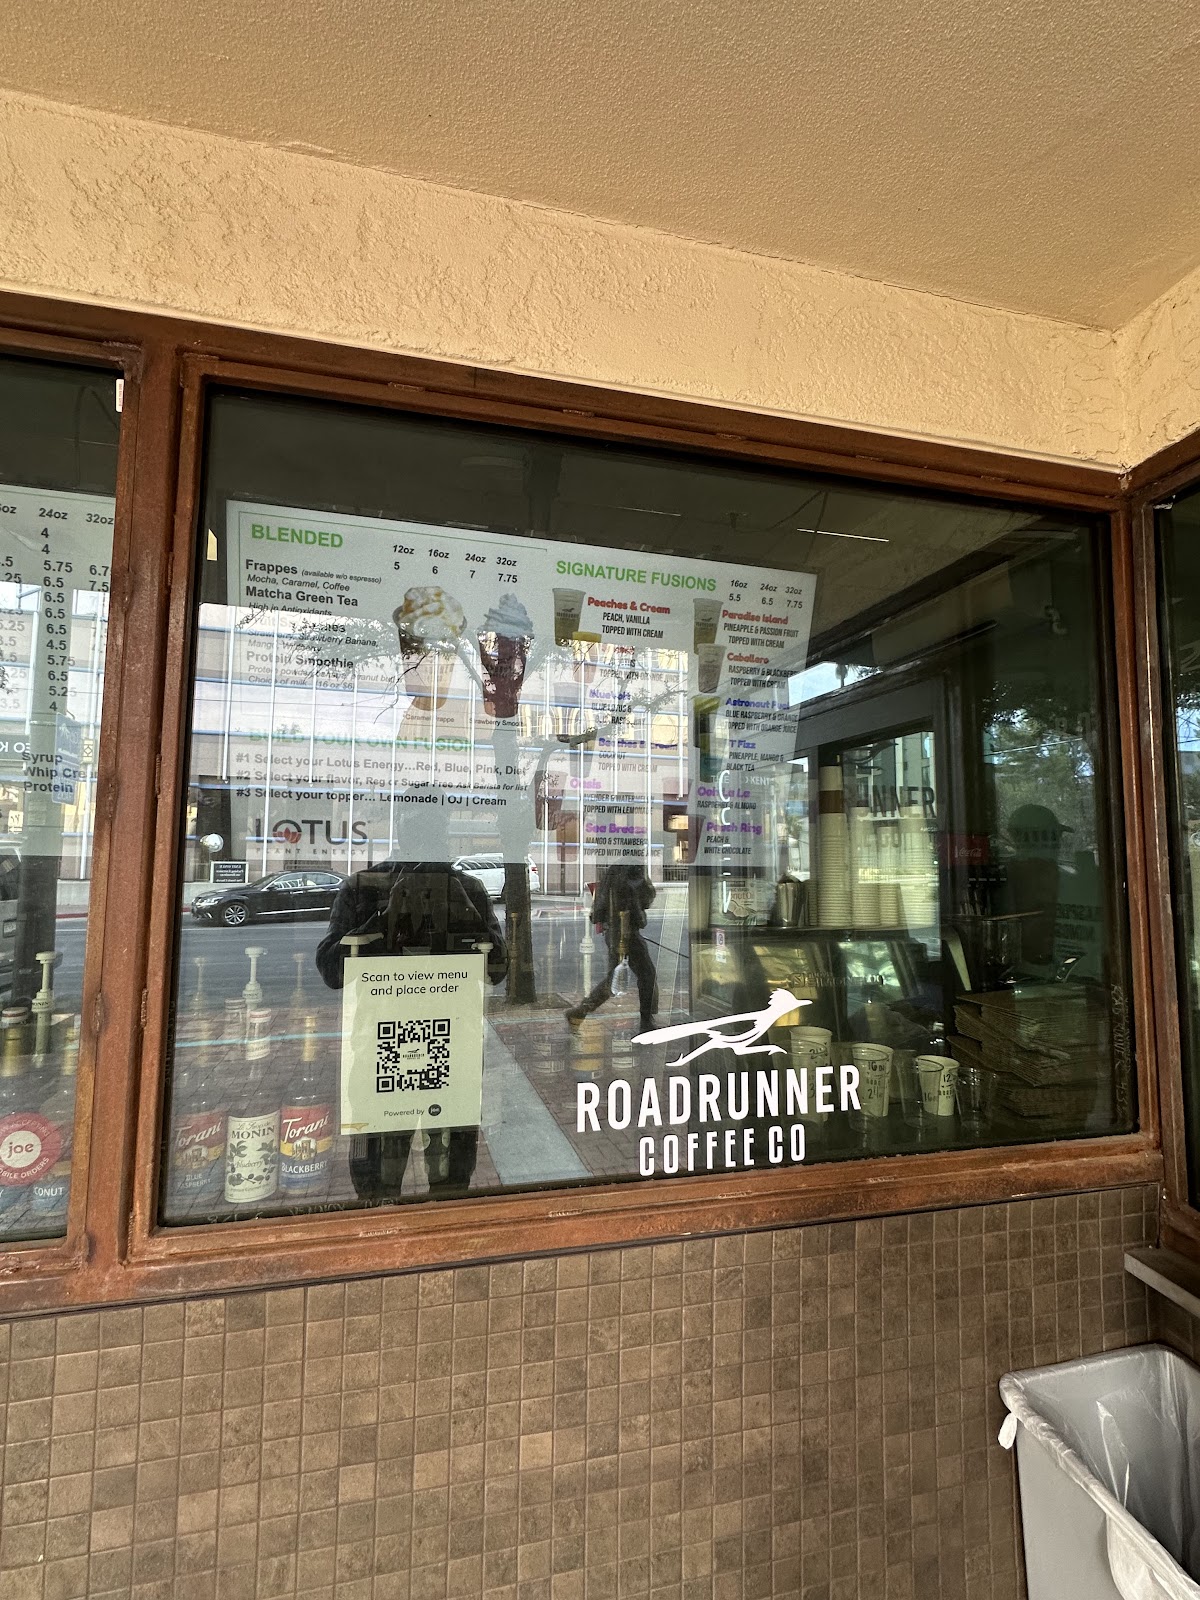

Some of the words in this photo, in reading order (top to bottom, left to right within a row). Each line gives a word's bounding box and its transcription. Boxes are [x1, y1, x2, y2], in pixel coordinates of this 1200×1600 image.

[39, 507, 68, 520] 24oz
[86, 513, 114, 525] 32oz
[41, 527, 50, 539] 4
[252, 524, 343, 549] BLENDED
[42, 544, 50, 555] 4
[392, 544, 415, 555] 12oz
[428, 548, 450, 559] 16oz
[465, 553, 487, 563] 24oz
[496, 557, 517, 567] 32oz
[44, 560, 73, 573] 5.75
[89, 565, 110, 576] 6.7
[245, 559, 298, 575] Frappes
[302, 568, 335, 579] (available
[349, 574, 382, 584] espresso)
[394, 561, 400, 570] 5
[432, 565, 438, 574] 6
[469, 570, 476, 578] 7
[498, 573, 518, 583] 7.75
[43, 576, 64, 588] 6.5
[247, 574, 279, 586] Mocha,
[281, 577, 320, 590] Caramel,
[323, 581, 350, 592] Coffee
[556, 560, 647, 584] SIGNATURE
[651, 571, 717, 592] FUSIONS
[730, 580, 748, 588] 16oz
[760, 583, 778, 592] 24oz
[785, 586, 803, 595] 32oz
[44, 592, 65, 603] 6.5
[245, 585, 292, 601] Matcha
[296, 590, 334, 605] Green
[337, 594, 358, 607] Tea
[728, 593, 741, 602] 5.5
[761, 597, 774, 605] 6.5
[786, 600, 803, 609] 7.75
[587, 597, 628, 610] Peaches
[629, 601, 638, 611] &
[639, 602, 671, 615] Cream
[45, 608, 66, 620] 6.5
[602, 612, 624, 624] PEACH,
[625, 614, 650, 625] VANILLA
[722, 609, 761, 622] Paradise
[762, 613, 789, 625] Island
[46, 624, 67, 635] 6.5
[602, 625, 626, 635] TOPPED
[626, 627, 641, 637] WITH
[642, 628, 664, 639] CREAM
[723, 622, 754, 634] PINEAPPLE
[759, 626, 782, 637] PASSION
[783, 628, 800, 638] FRUIT
[46, 639, 67, 651] 4.5
[345, 636, 379, 648] Banana,
[728, 635, 749, 646] TOPPED
[750, 638, 764, 647] WITH
[765, 638, 785, 649] CREAM
[47, 654, 76, 667] 5.75
[246, 650, 291, 664] Protein
[295, 655, 354, 669] Smoothie
[727, 652, 769, 664] Caballero
[48, 670, 69, 682] 6.5
[728, 665, 760, 676] RASPBERRY
[49, 685, 77, 698] 5.25
[49, 702, 58, 713] 4
[725, 698, 770, 709] Astronaut
[725, 709, 740, 719] BLUE
[740, 710, 772, 721] RASPBERRY
[737, 740, 756, 749] Fizz
[22, 752, 63, 766] Syrup
[236, 752, 250, 763] #1
[254, 753, 293, 765] Select
[295, 757, 323, 768] your
[326, 757, 360, 768] Lotus
[475, 764, 502, 774] Pink,
[23, 766, 58, 780] Whip
[726, 763, 744, 771] BLACK
[745, 763, 755, 772] TEA
[236, 770, 251, 781] #2
[254, 770, 293, 782] Select
[295, 774, 323, 785] your
[326, 773, 363, 785] flavor,
[366, 776, 386, 788] Reg
[401, 778, 430, 789] Sugar
[23, 781, 73, 793] Protein
[236, 788, 251, 798] #3
[254, 788, 293, 799] Select
[295, 790, 323, 801] your
[379, 793, 438, 804] Lemonade
[447, 796, 463, 805] OJ
[472, 796, 507, 806] Cream
[583, 804, 606, 814] TOPPED
[607, 805, 621, 814] WITH
[734, 801, 757, 810] ALMOND
[255, 818, 368, 846] LOTUS
[585, 823, 607, 833] Sea
[740, 823, 763, 835] Ring
[585, 837, 607, 845] MANGO
[706, 835, 725, 844] PEACH
[584, 848, 606, 857] TOPPED
[606, 848, 621, 857] WITH
[622, 848, 645, 857] ORANGE
[704, 846, 721, 855] WHITE
[722, 846, 752, 855] CHOCOLATE
[361, 972, 390, 983] Scan
[393, 972, 405, 982] to
[407, 971, 434, 981] view
[437, 970, 468, 980] menu
[370, 985, 393, 996] and
[396, 984, 426, 997] place
[429, 983, 459, 994] order
[576, 1064, 862, 1133] ROADRUNNER
[383, 1109, 415, 1117] Powered
[416, 1108, 425, 1117] by
[175, 1117, 223, 1150] Torani
[231, 1125, 275, 1140] MONIN
[282, 1111, 330, 1144] Torani
[7, 1142, 34, 1159] joe
[639, 1127, 755, 1177] COFFEE
[768, 1123, 806, 1164] CO
[20, 1156, 50, 1179] ORDERS
[281, 1160, 328, 1175] BLACKBERRY
